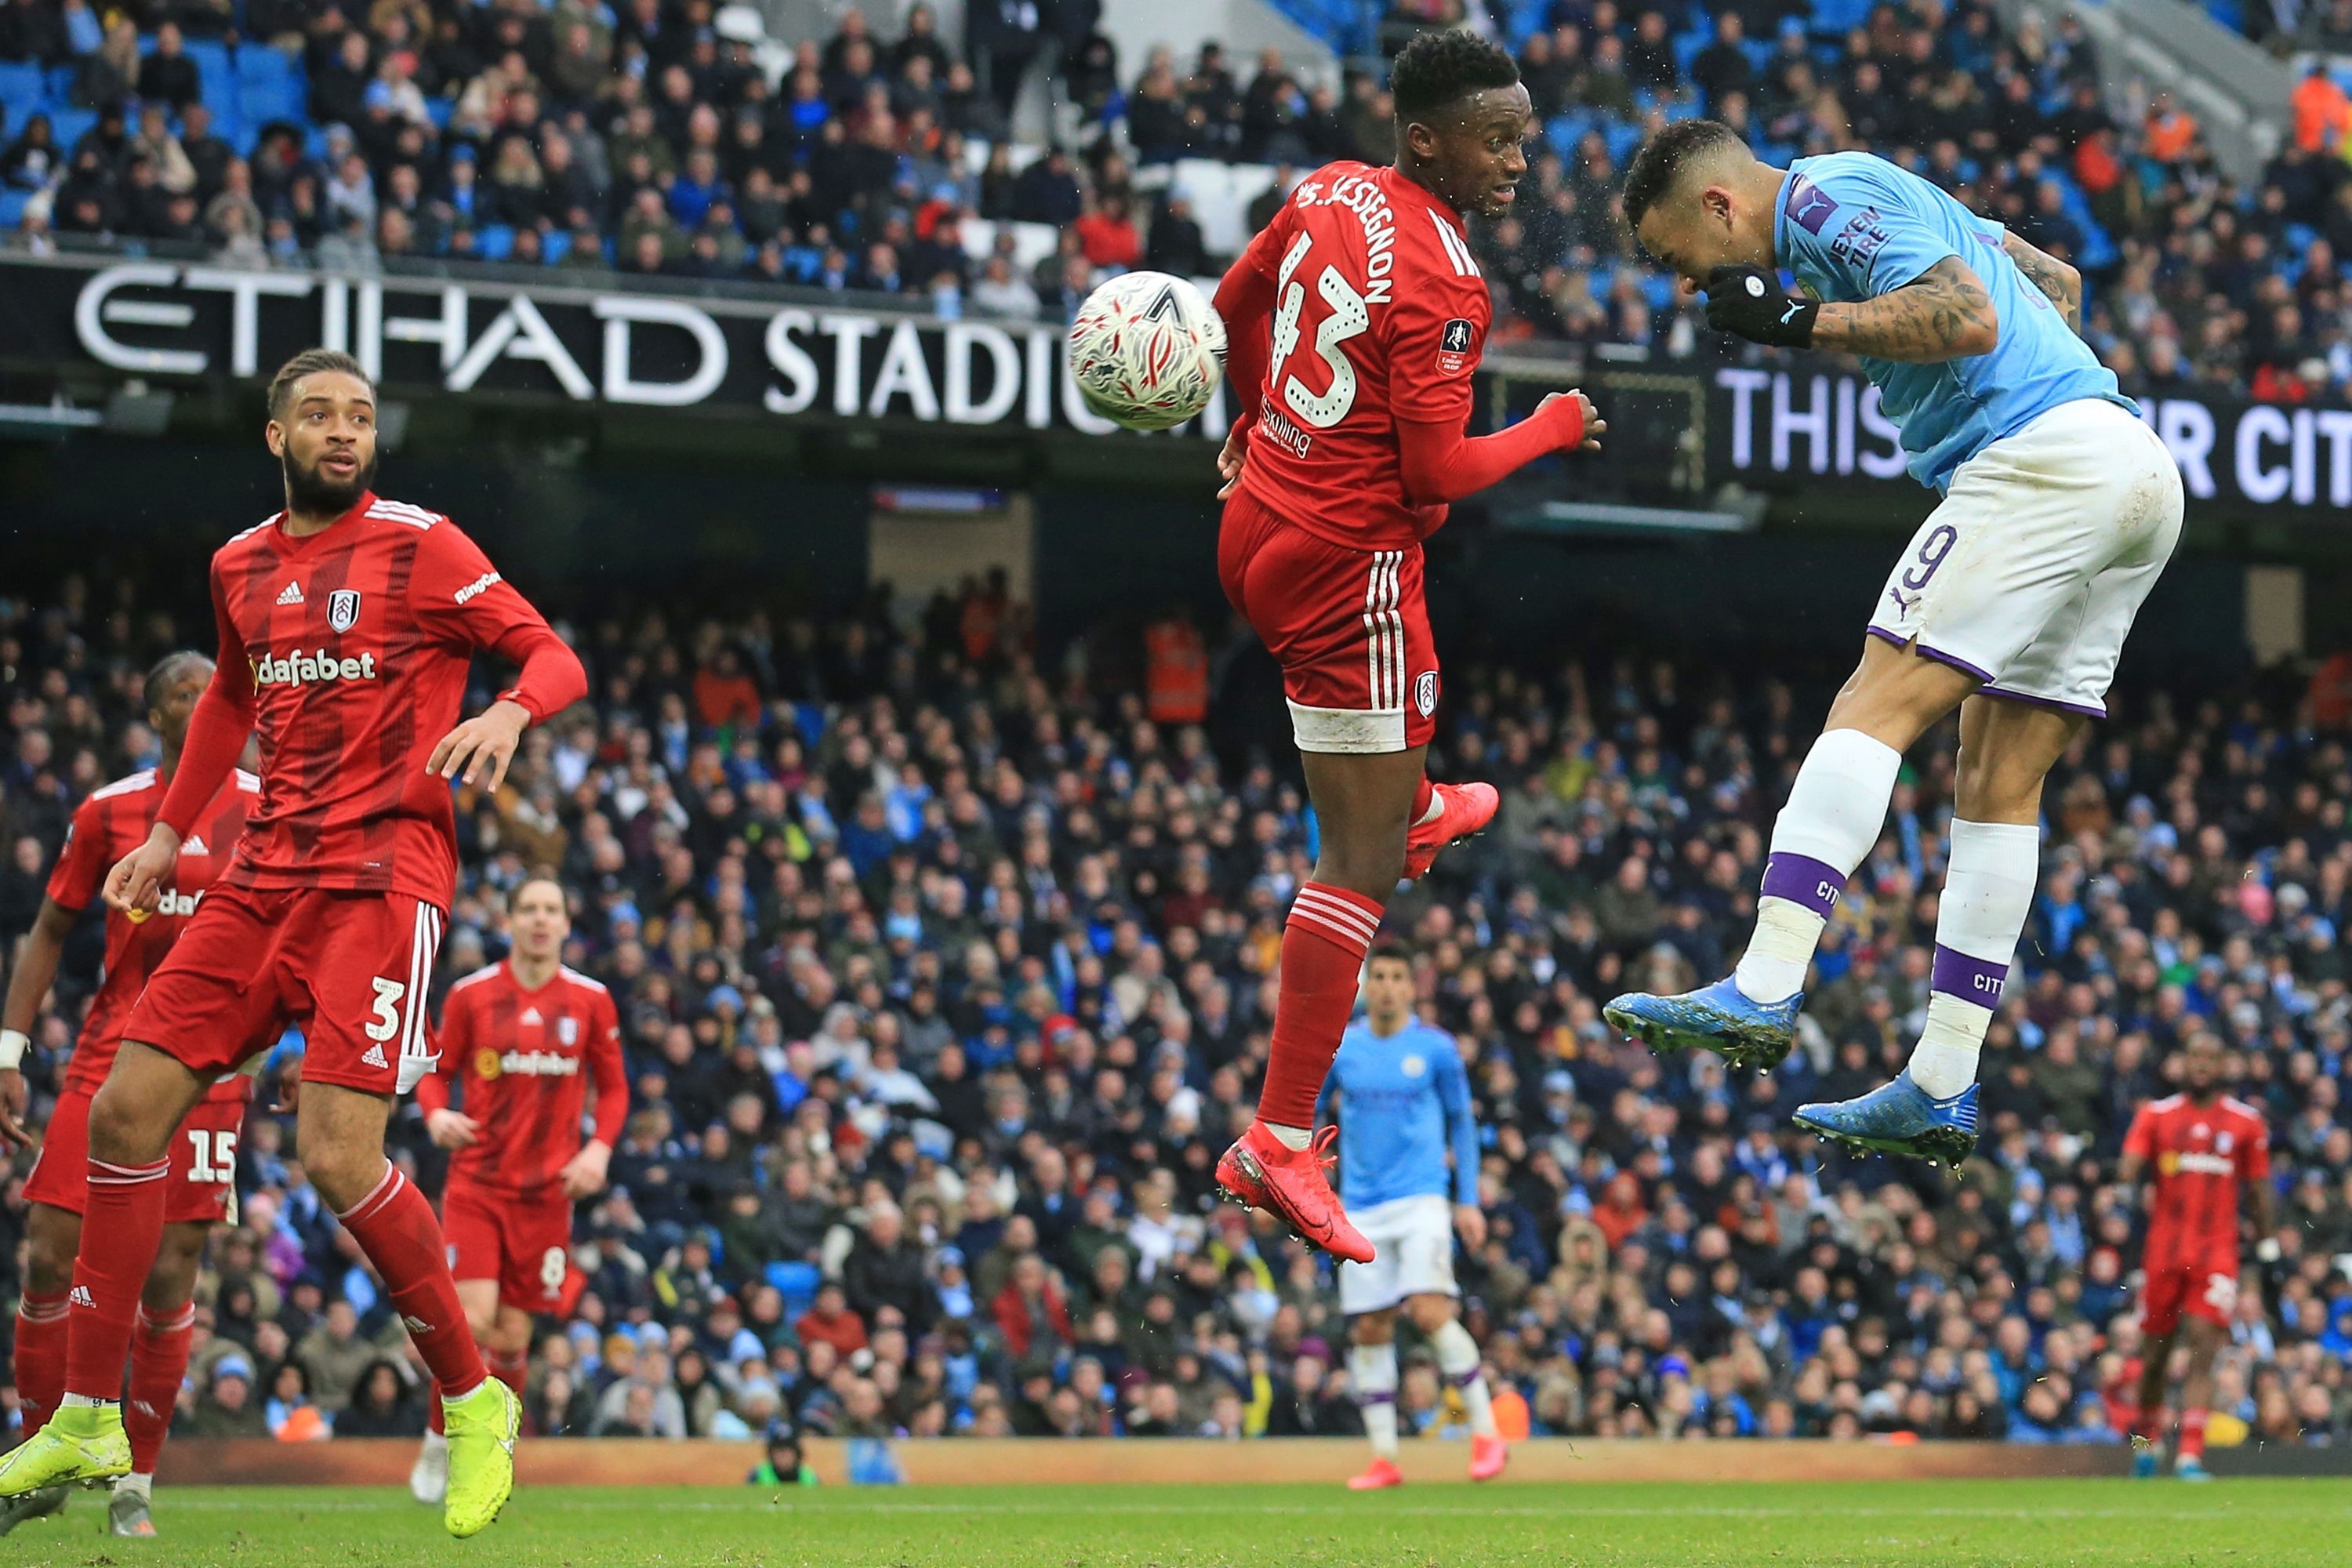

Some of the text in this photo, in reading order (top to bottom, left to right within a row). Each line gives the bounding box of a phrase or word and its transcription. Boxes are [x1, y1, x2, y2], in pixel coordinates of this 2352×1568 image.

[1848, 225, 1889, 269] TIRE
[75, 264, 728, 406] ETIHAD
[1270, 229, 1370, 428] 43
[1715, 367, 1908, 479] THIS
[1902, 524, 1958, 590] 9
[276, 594, 305, 605] adidas
[258, 648, 376, 688] dafabet
[365, 975, 405, 1042] 3
[361, 1054, 389, 1069] adidas
[187, 1129, 237, 1182] 15
[540, 1246, 566, 1287] 8
